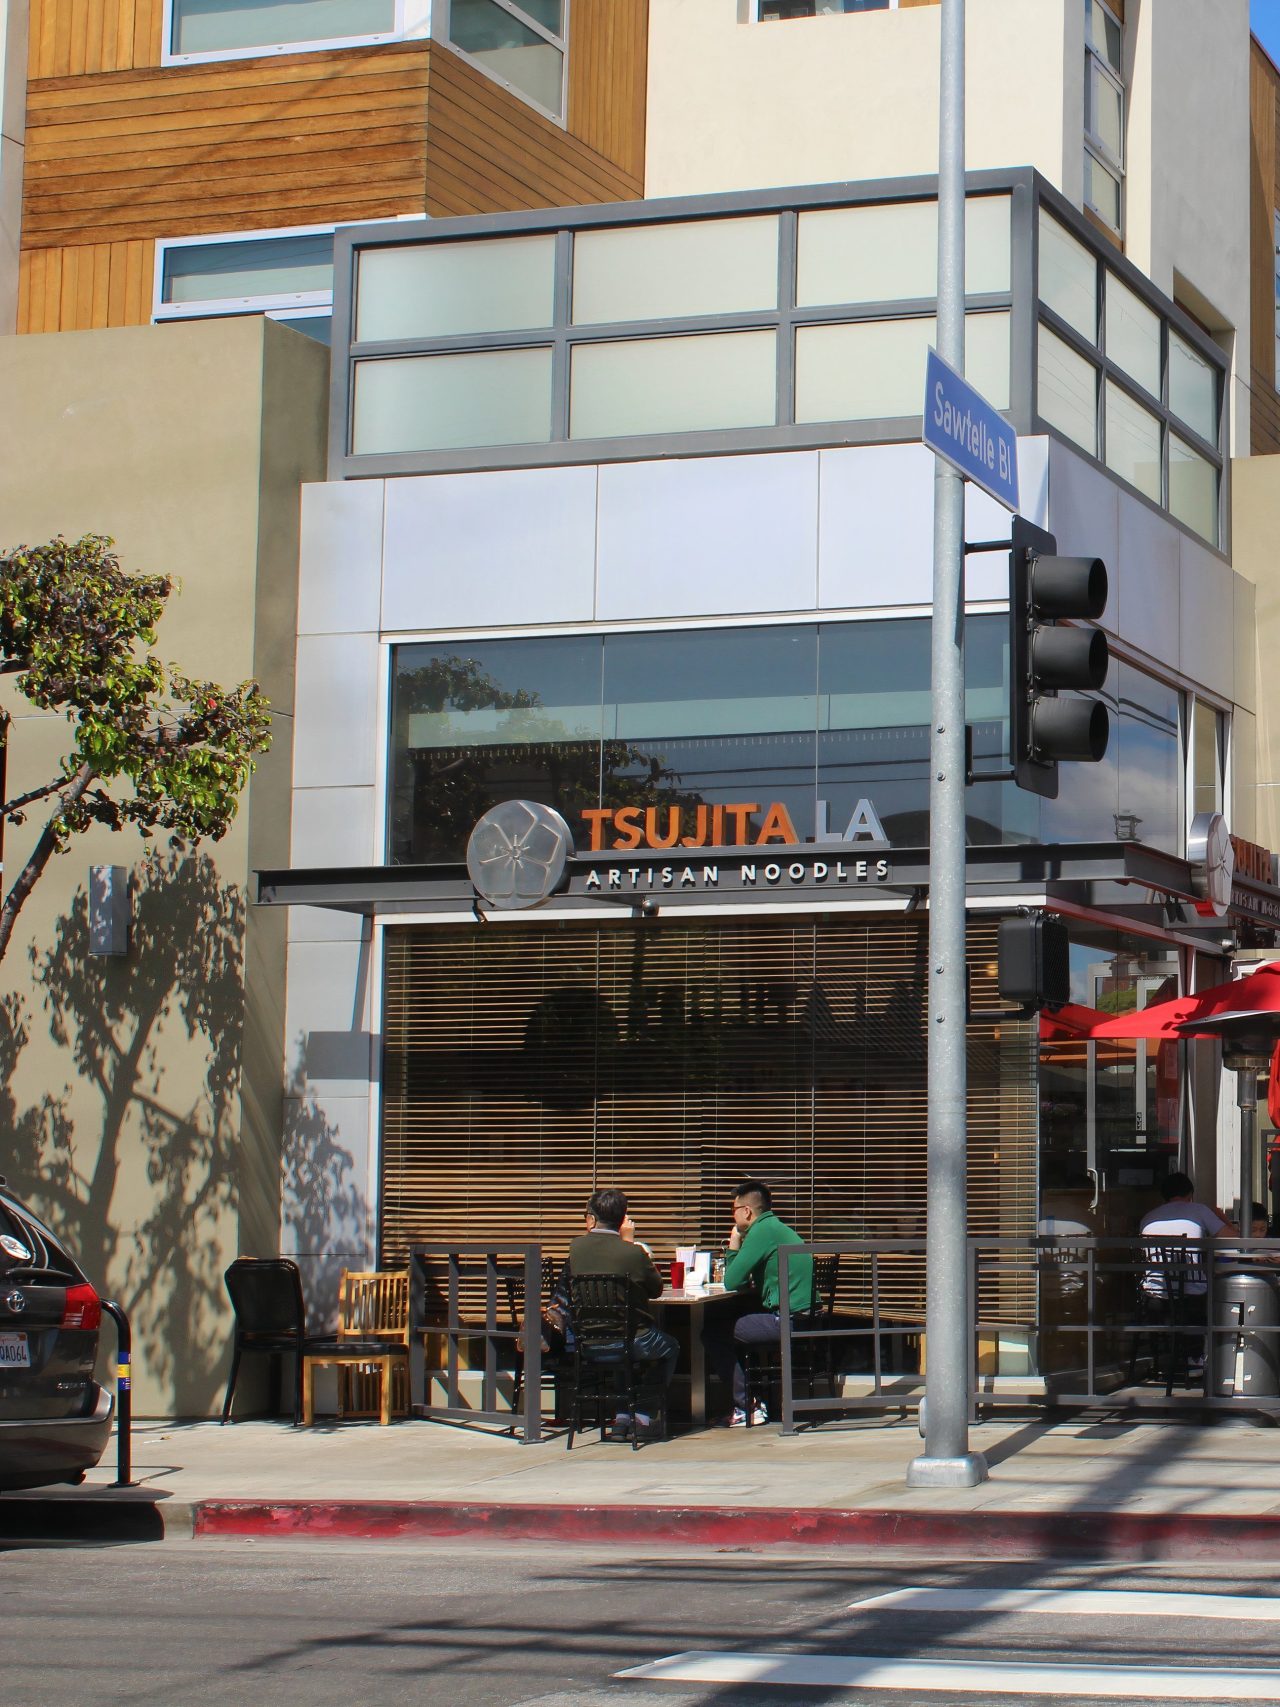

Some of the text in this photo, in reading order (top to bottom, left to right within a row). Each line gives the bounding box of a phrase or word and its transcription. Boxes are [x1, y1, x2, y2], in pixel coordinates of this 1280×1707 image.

[934, 381, 1012, 485] Sawtelle Bl
[581, 798, 888, 852] TSUJITA LA
[586, 859, 889, 886] ARTISAN NOODLES
